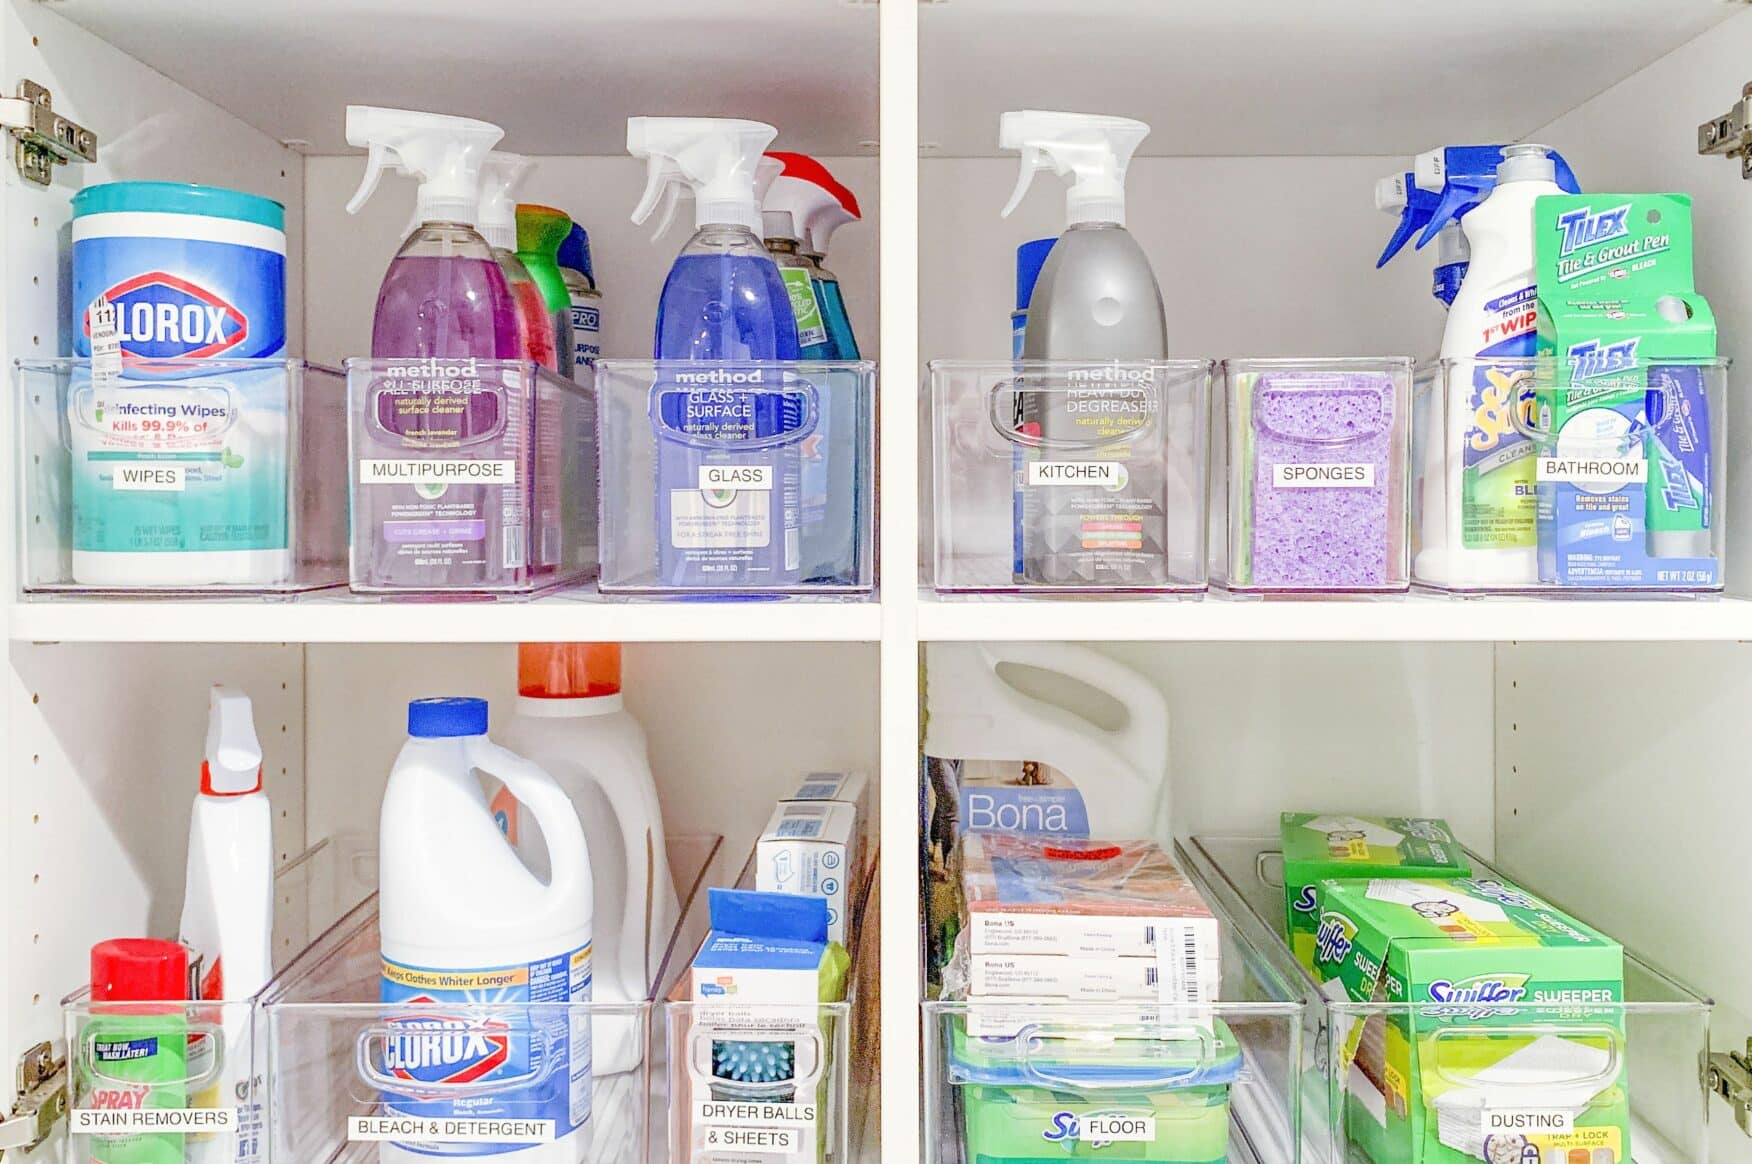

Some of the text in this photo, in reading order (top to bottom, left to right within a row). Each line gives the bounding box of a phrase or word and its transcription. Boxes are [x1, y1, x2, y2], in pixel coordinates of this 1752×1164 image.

[1558, 234, 1670, 276] Tile & Grout Pen
[1502, 302, 1534, 318] from the
[1500, 312, 1537, 335] WIP
[388, 358, 478, 378] method
[1068, 359, 1154, 381] method
[676, 369, 764, 384] method
[395, 397, 468, 406] naturally derived
[689, 391, 734, 403] GLASS
[398, 406, 464, 414] surface cleaner
[687, 406, 752, 418] SURFACE
[1067, 400, 1160, 413] DEGREASER
[113, 420, 208, 432] Kills 99.9% of
[684, 422, 754, 432] naturally derived
[1076, 417, 1114, 426] naturally
[715, 432, 747, 440] cleaner
[372, 463, 504, 477] MULTIPURPOSE
[708, 469, 763, 482] GLASS
[1039, 466, 1110, 478] KITCHEN
[1283, 466, 1366, 480] SPONGES
[1546, 461, 1640, 476] BATHROOM
[123, 470, 176, 484] WIPES
[968, 794, 1068, 831] Bona
[406, 972, 438, 986] Clothes
[439, 974, 474, 986] Whiter
[476, 974, 514, 988] Longer
[1427, 980, 1612, 1008] Swiffer SWEEPER
[386, 1022, 490, 1070] CLOROX
[92, 1086, 149, 1109] SPRAY
[453, 1098, 494, 1108] Regular
[80, 1112, 228, 1126] STAIN REMOVERS
[702, 1104, 814, 1120] DRYER BALLS
[358, 1120, 546, 1136] BLEACH & DETERGENT
[1090, 1120, 1146, 1134] FLOOR
[1491, 1114, 1564, 1128] DUSTING
[708, 1131, 790, 1146] & SHEETS
